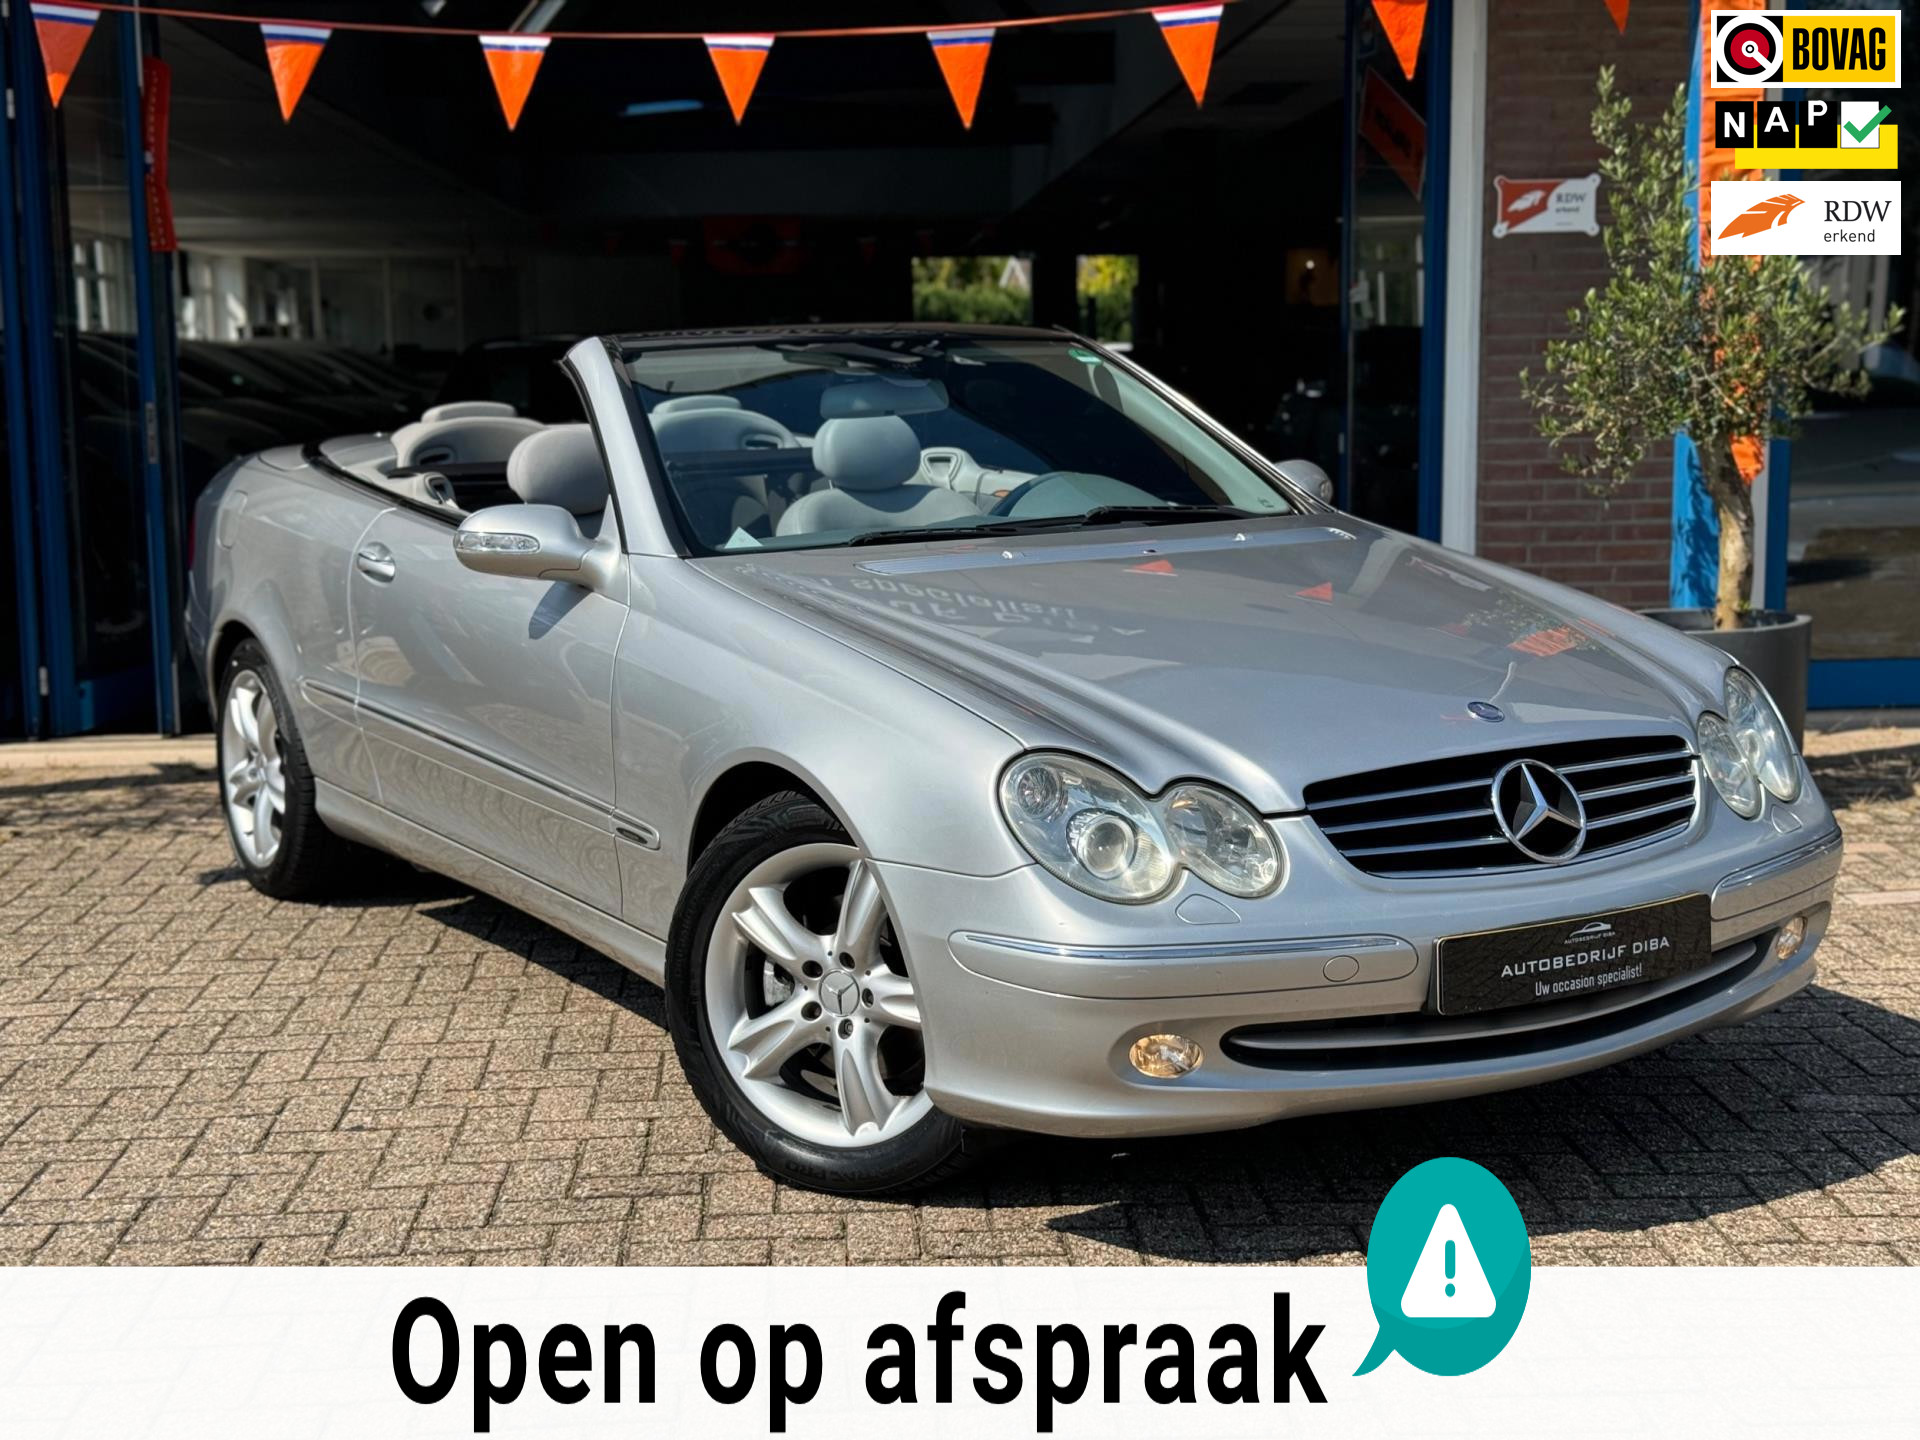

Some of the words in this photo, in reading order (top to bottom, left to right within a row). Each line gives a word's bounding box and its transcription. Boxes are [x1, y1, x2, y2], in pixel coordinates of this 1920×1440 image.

[1556, 192, 1587, 203] RDW
[1563, 934, 1602, 944] AUTOBEDRIJF
[1603, 930, 1616, 938] DIBA
[1501, 945, 1627, 978] AUTOBEDRIJF
[1633, 935, 1670, 955] DIBA
[1535, 981, 1550, 997] Uw
[1553, 975, 1595, 994] occasion
[1597, 962, 1643, 986] specialist!
